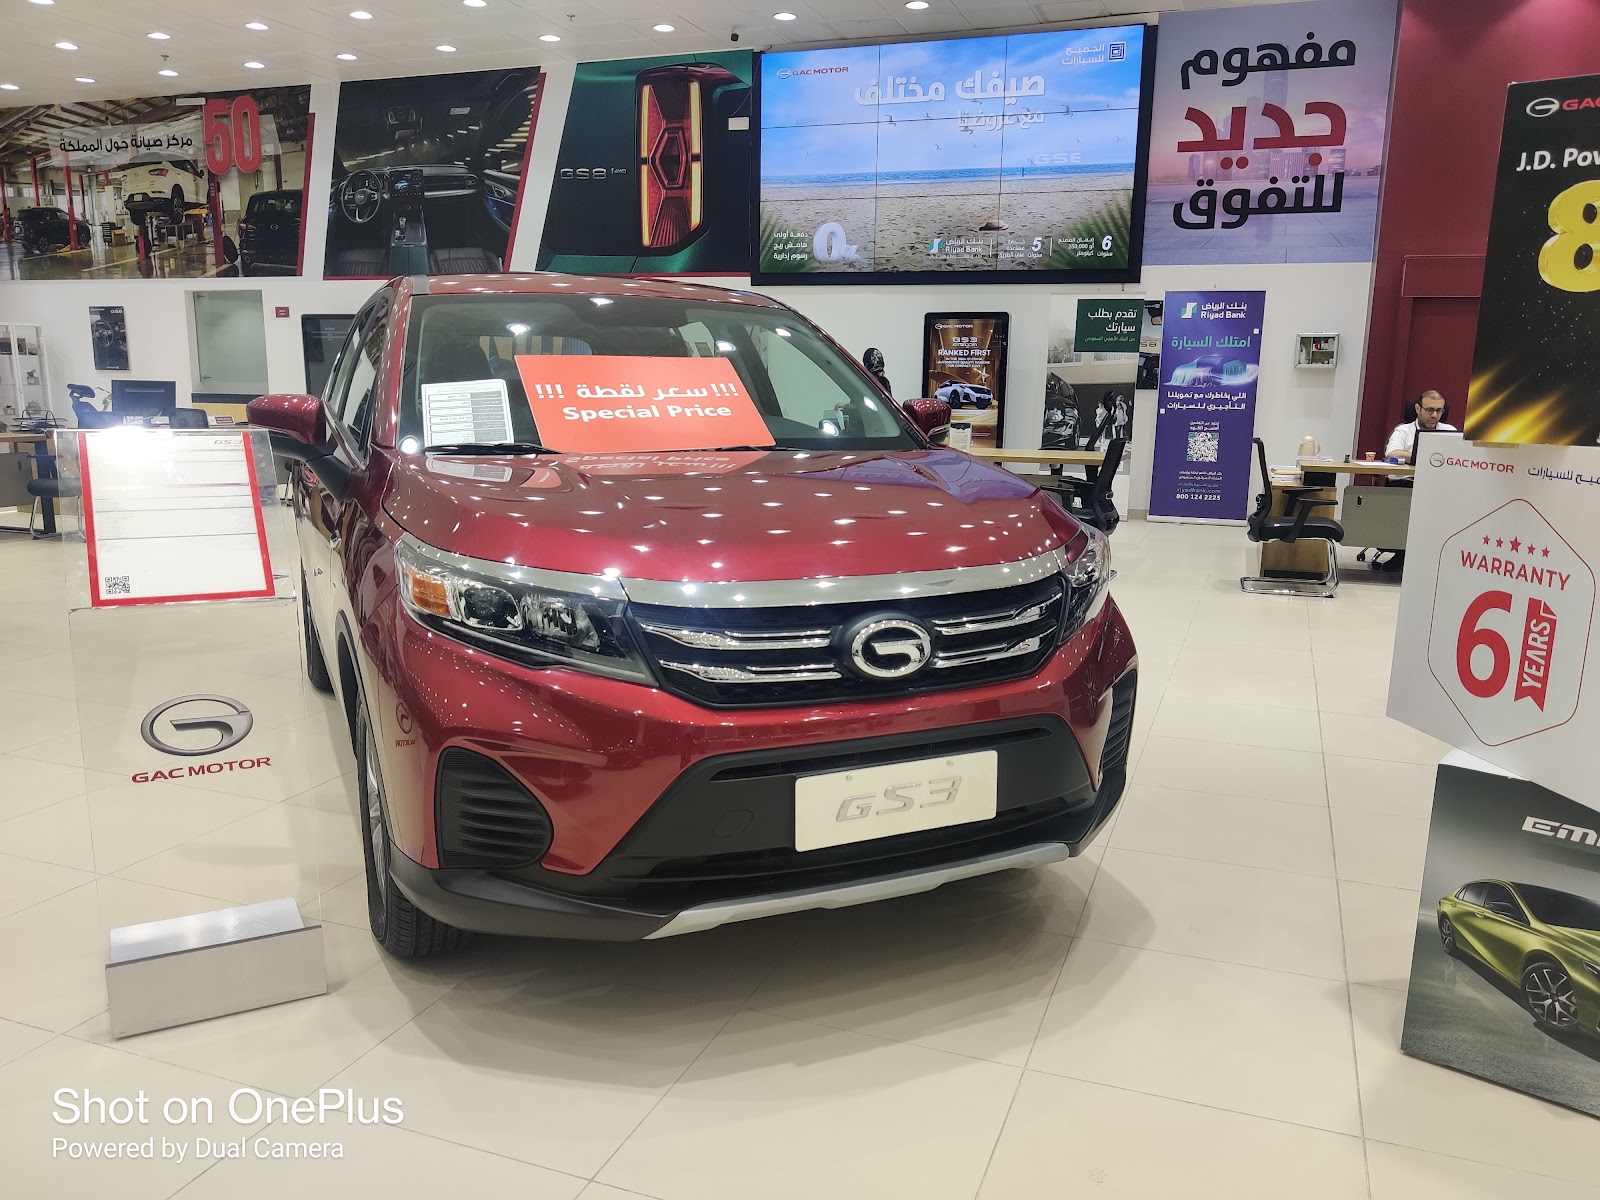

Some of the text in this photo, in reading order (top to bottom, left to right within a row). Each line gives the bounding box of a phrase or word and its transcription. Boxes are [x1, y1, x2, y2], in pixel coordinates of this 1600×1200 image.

[1062, 54, 1104, 66] للسيارات
[1180, 31, 1356, 90] مفهوم
[813, 66, 849, 75] MOTOR
[854, 69, 1045, 106] صيفك مختلف
[202, 96, 262, 175] 50
[1177, 101, 1347, 170] جديد
[59, 134, 193, 153] مركز صيانة حول المملكة
[1515, 150, 1556, 172] J.D.
[560, 168, 607, 180] GS8
[1172, 172, 1345, 230] للتفوق
[774, 229, 808, 240] دفعة أولى
[945, 237, 965, 246] الرياض
[784, 240, 808, 250] هامش
[946, 245, 982, 254] Riyad Bank
[1031, 236, 1042, 252] 5
[1101, 235, 1113, 251] 6
[773, 252, 808, 261] رسوم إدارية
[1088, 308, 1138, 320] تقدم بطلب
[1201, 302, 1225, 311] الرياض
[1200, 310, 1246, 320] Riyad Bank
[1105, 322, 1136, 334] سيارتك
[1171, 336, 1251, 350] امتلك السيارة
[534, 382, 740, 401] !!! سعر لقطة !!!
[1168, 391, 1193, 400] تمويلنا
[1205, 391, 1230, 401] بخاطرك
[1232, 392, 1246, 402] اللي
[562, 404, 732, 422] Special Price
[1166, 402, 1246, 412] التأجيري للسيارات
[1446, 457, 1514, 474] GAC MOTOR
[1528, 466, 1574, 481] للسيارات
[1460, 550, 1572, 591] WARRANTY
[1456, 590, 1513, 699] 6
[1521, 618, 1551, 689] YEARS
[131, 756, 272, 784] GAC MOTOR
[836, 775, 962, 822] GS3
[1522, 816, 1600, 847] EM
